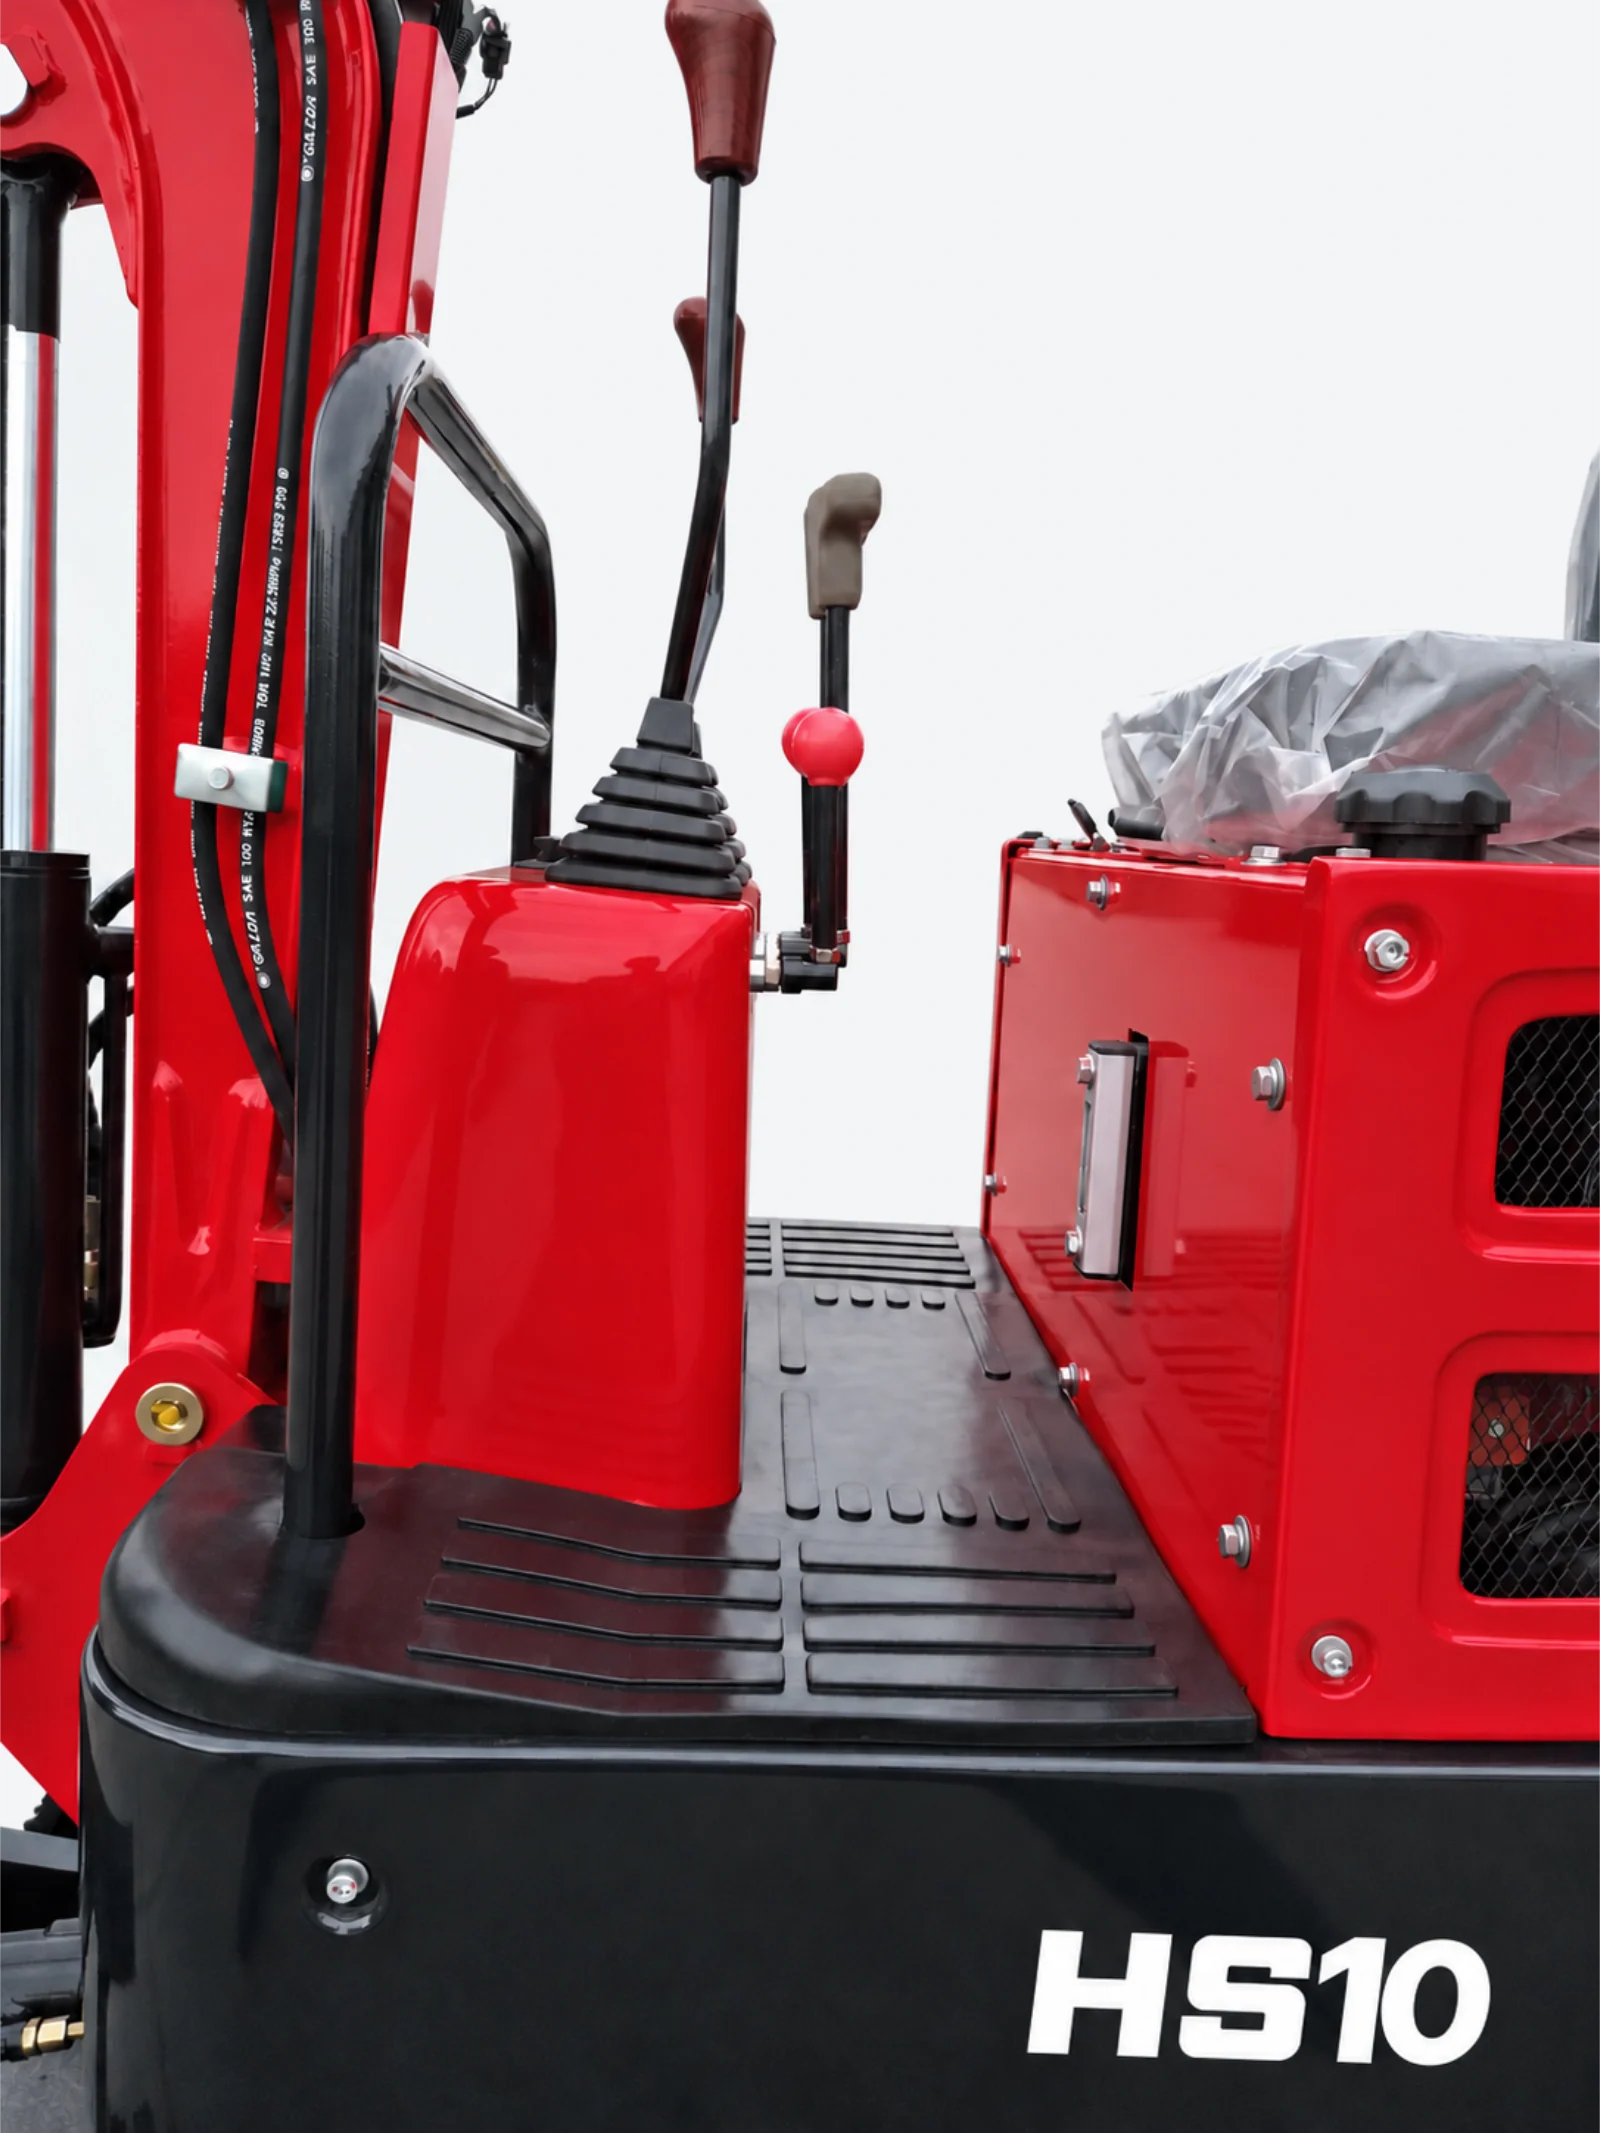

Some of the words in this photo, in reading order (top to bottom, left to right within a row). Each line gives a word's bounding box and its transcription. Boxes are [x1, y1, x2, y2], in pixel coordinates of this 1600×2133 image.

[241, 843, 252, 865] 100
[241, 874, 253, 902] SAE
[1027, 1930, 1491, 2066] HS10
